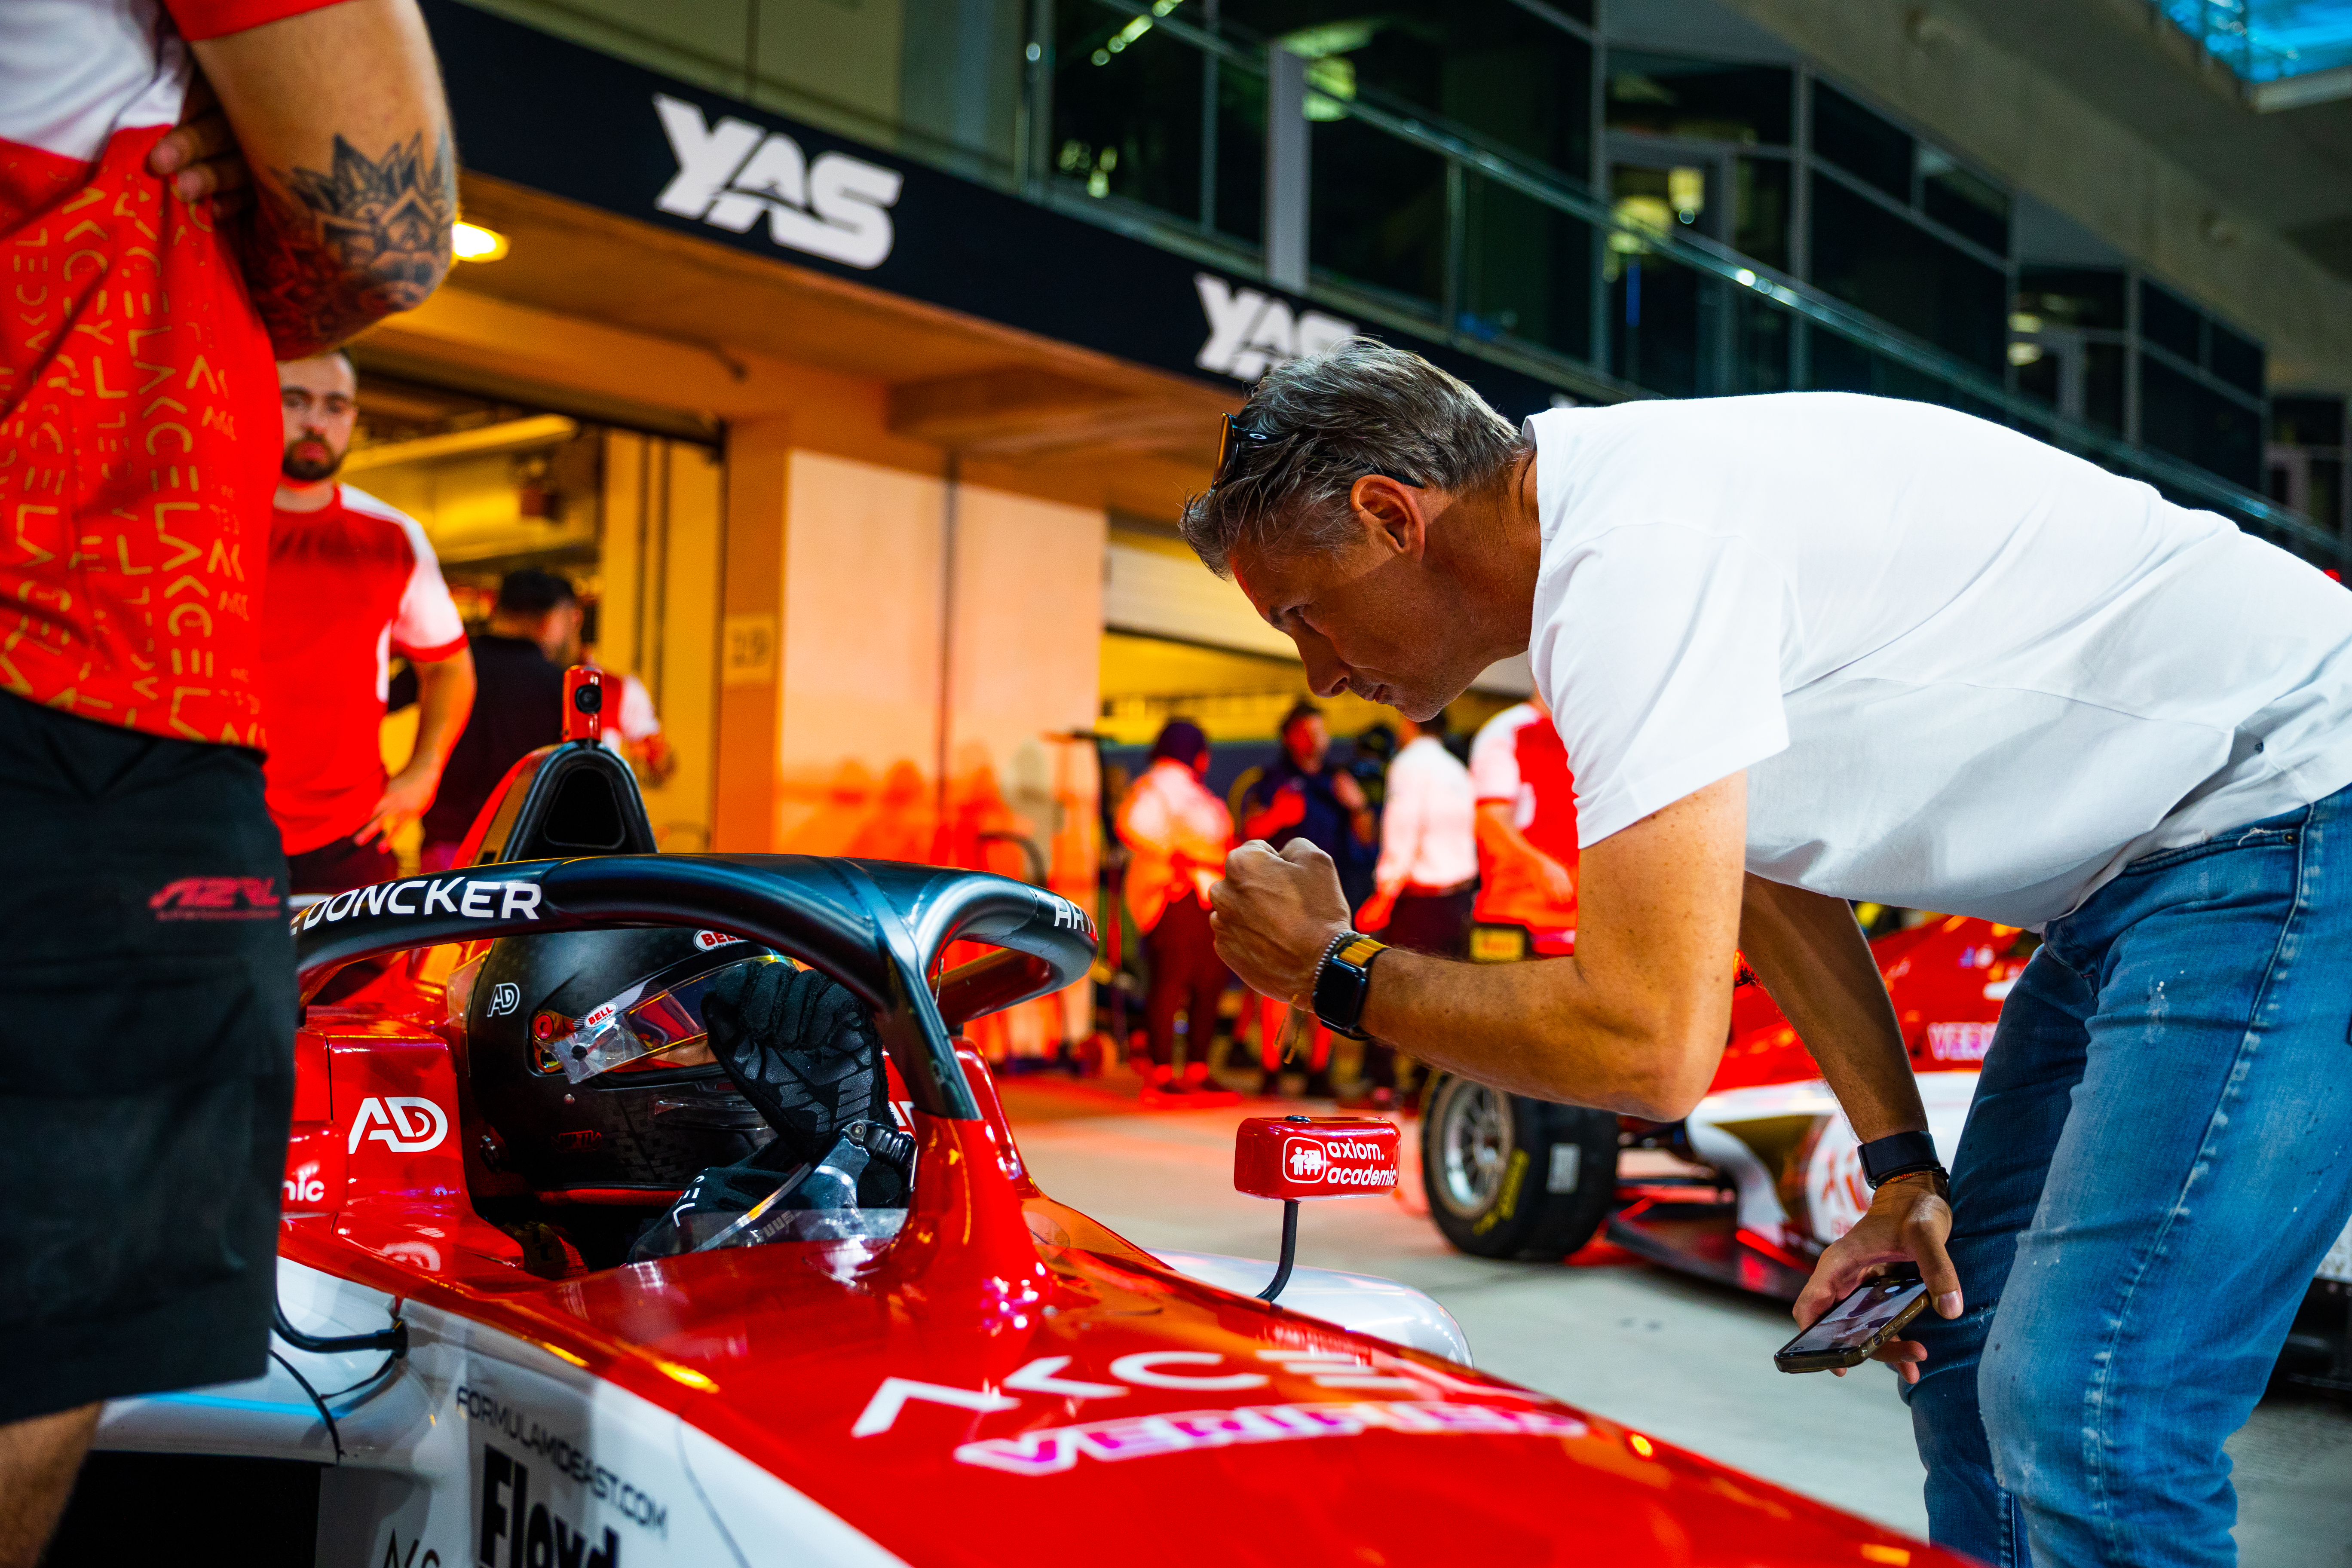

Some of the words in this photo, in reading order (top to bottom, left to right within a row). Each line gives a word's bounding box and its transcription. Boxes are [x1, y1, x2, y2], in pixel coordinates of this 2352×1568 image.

[652, 92, 905, 270] YAS
[701, 932, 743, 946] BEL
[487, 983, 520, 1017] AD
[588, 1007, 613, 1025] BELL
[349, 1096, 448, 1154] AD
[1326, 1138, 1385, 1161] axiom.
[1326, 1164, 1397, 1186] academic
